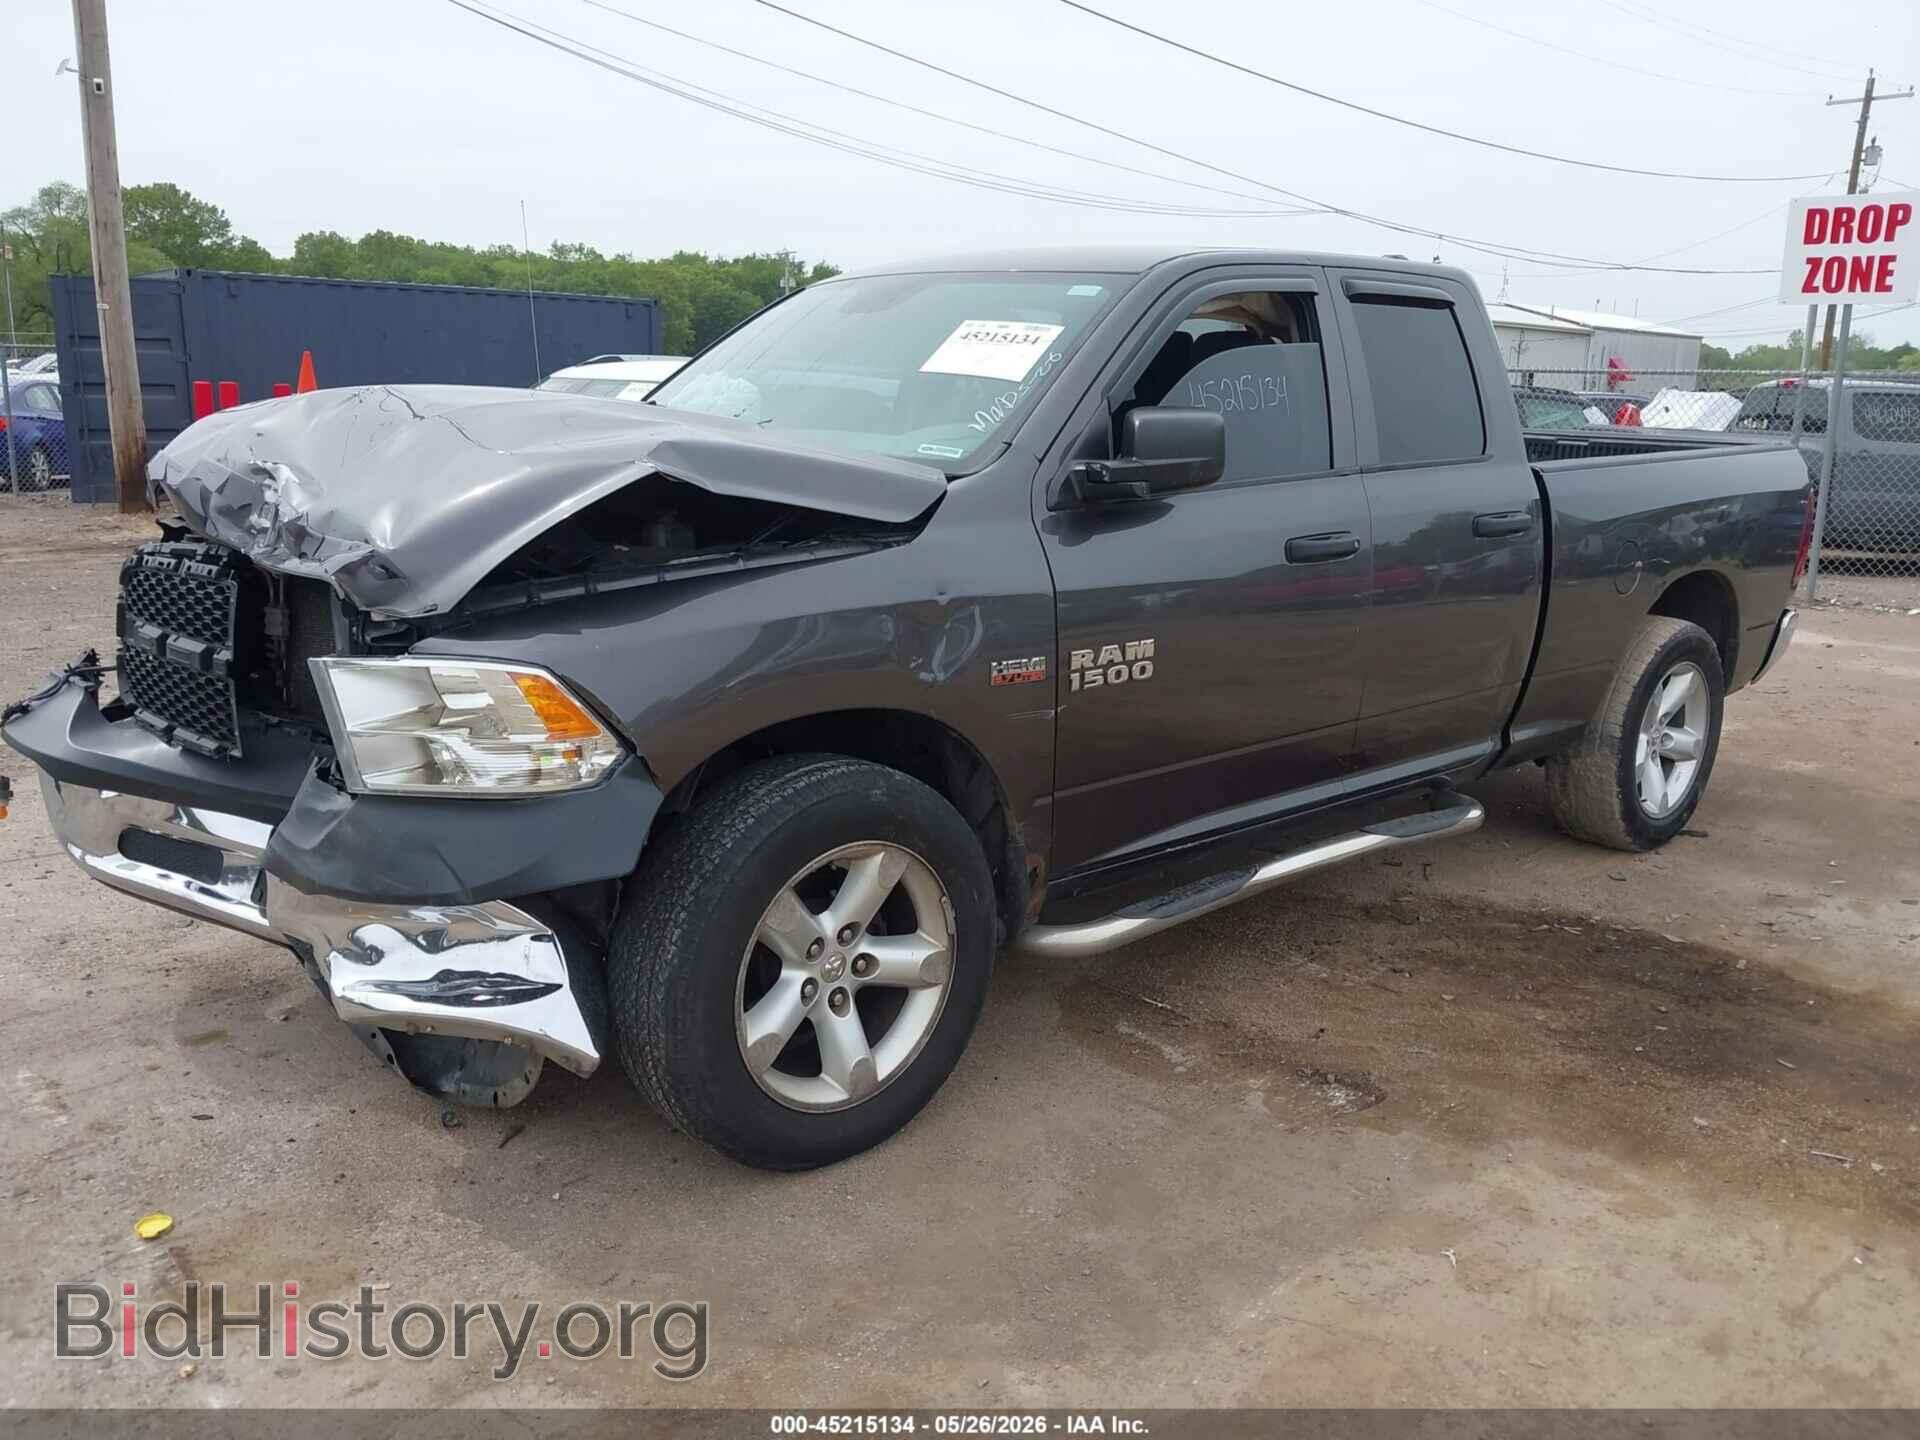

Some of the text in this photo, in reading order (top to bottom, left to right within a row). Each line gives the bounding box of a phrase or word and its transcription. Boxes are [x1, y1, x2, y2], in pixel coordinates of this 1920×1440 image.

[1803, 203, 1912, 245] DROP
[1801, 255, 1897, 293] ZONE
[1188, 374, 1289, 416] 45215134
[1070, 638, 1155, 670] RAM
[1070, 660, 1154, 692] 1500
